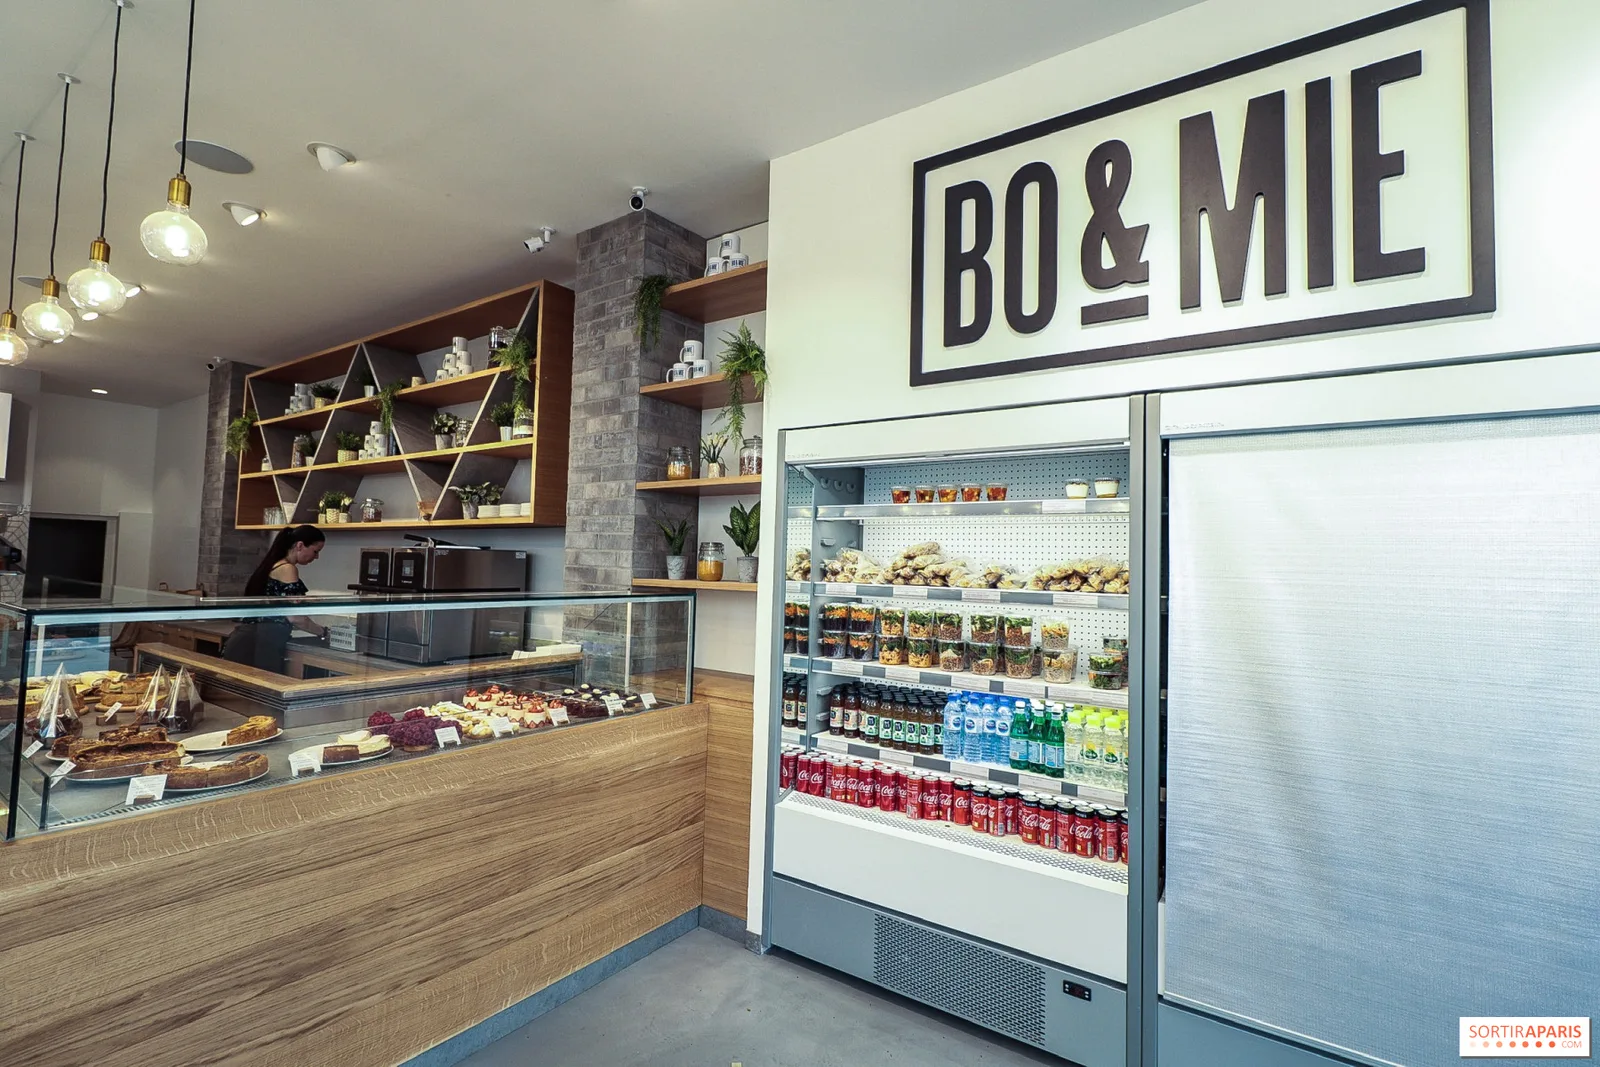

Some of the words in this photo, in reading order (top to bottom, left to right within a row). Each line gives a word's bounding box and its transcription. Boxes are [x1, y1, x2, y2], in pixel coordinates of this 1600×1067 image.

[944, 161, 1058, 348] BO
[1081, 139, 1149, 291] &
[1179, 50, 1425, 312] MIE
